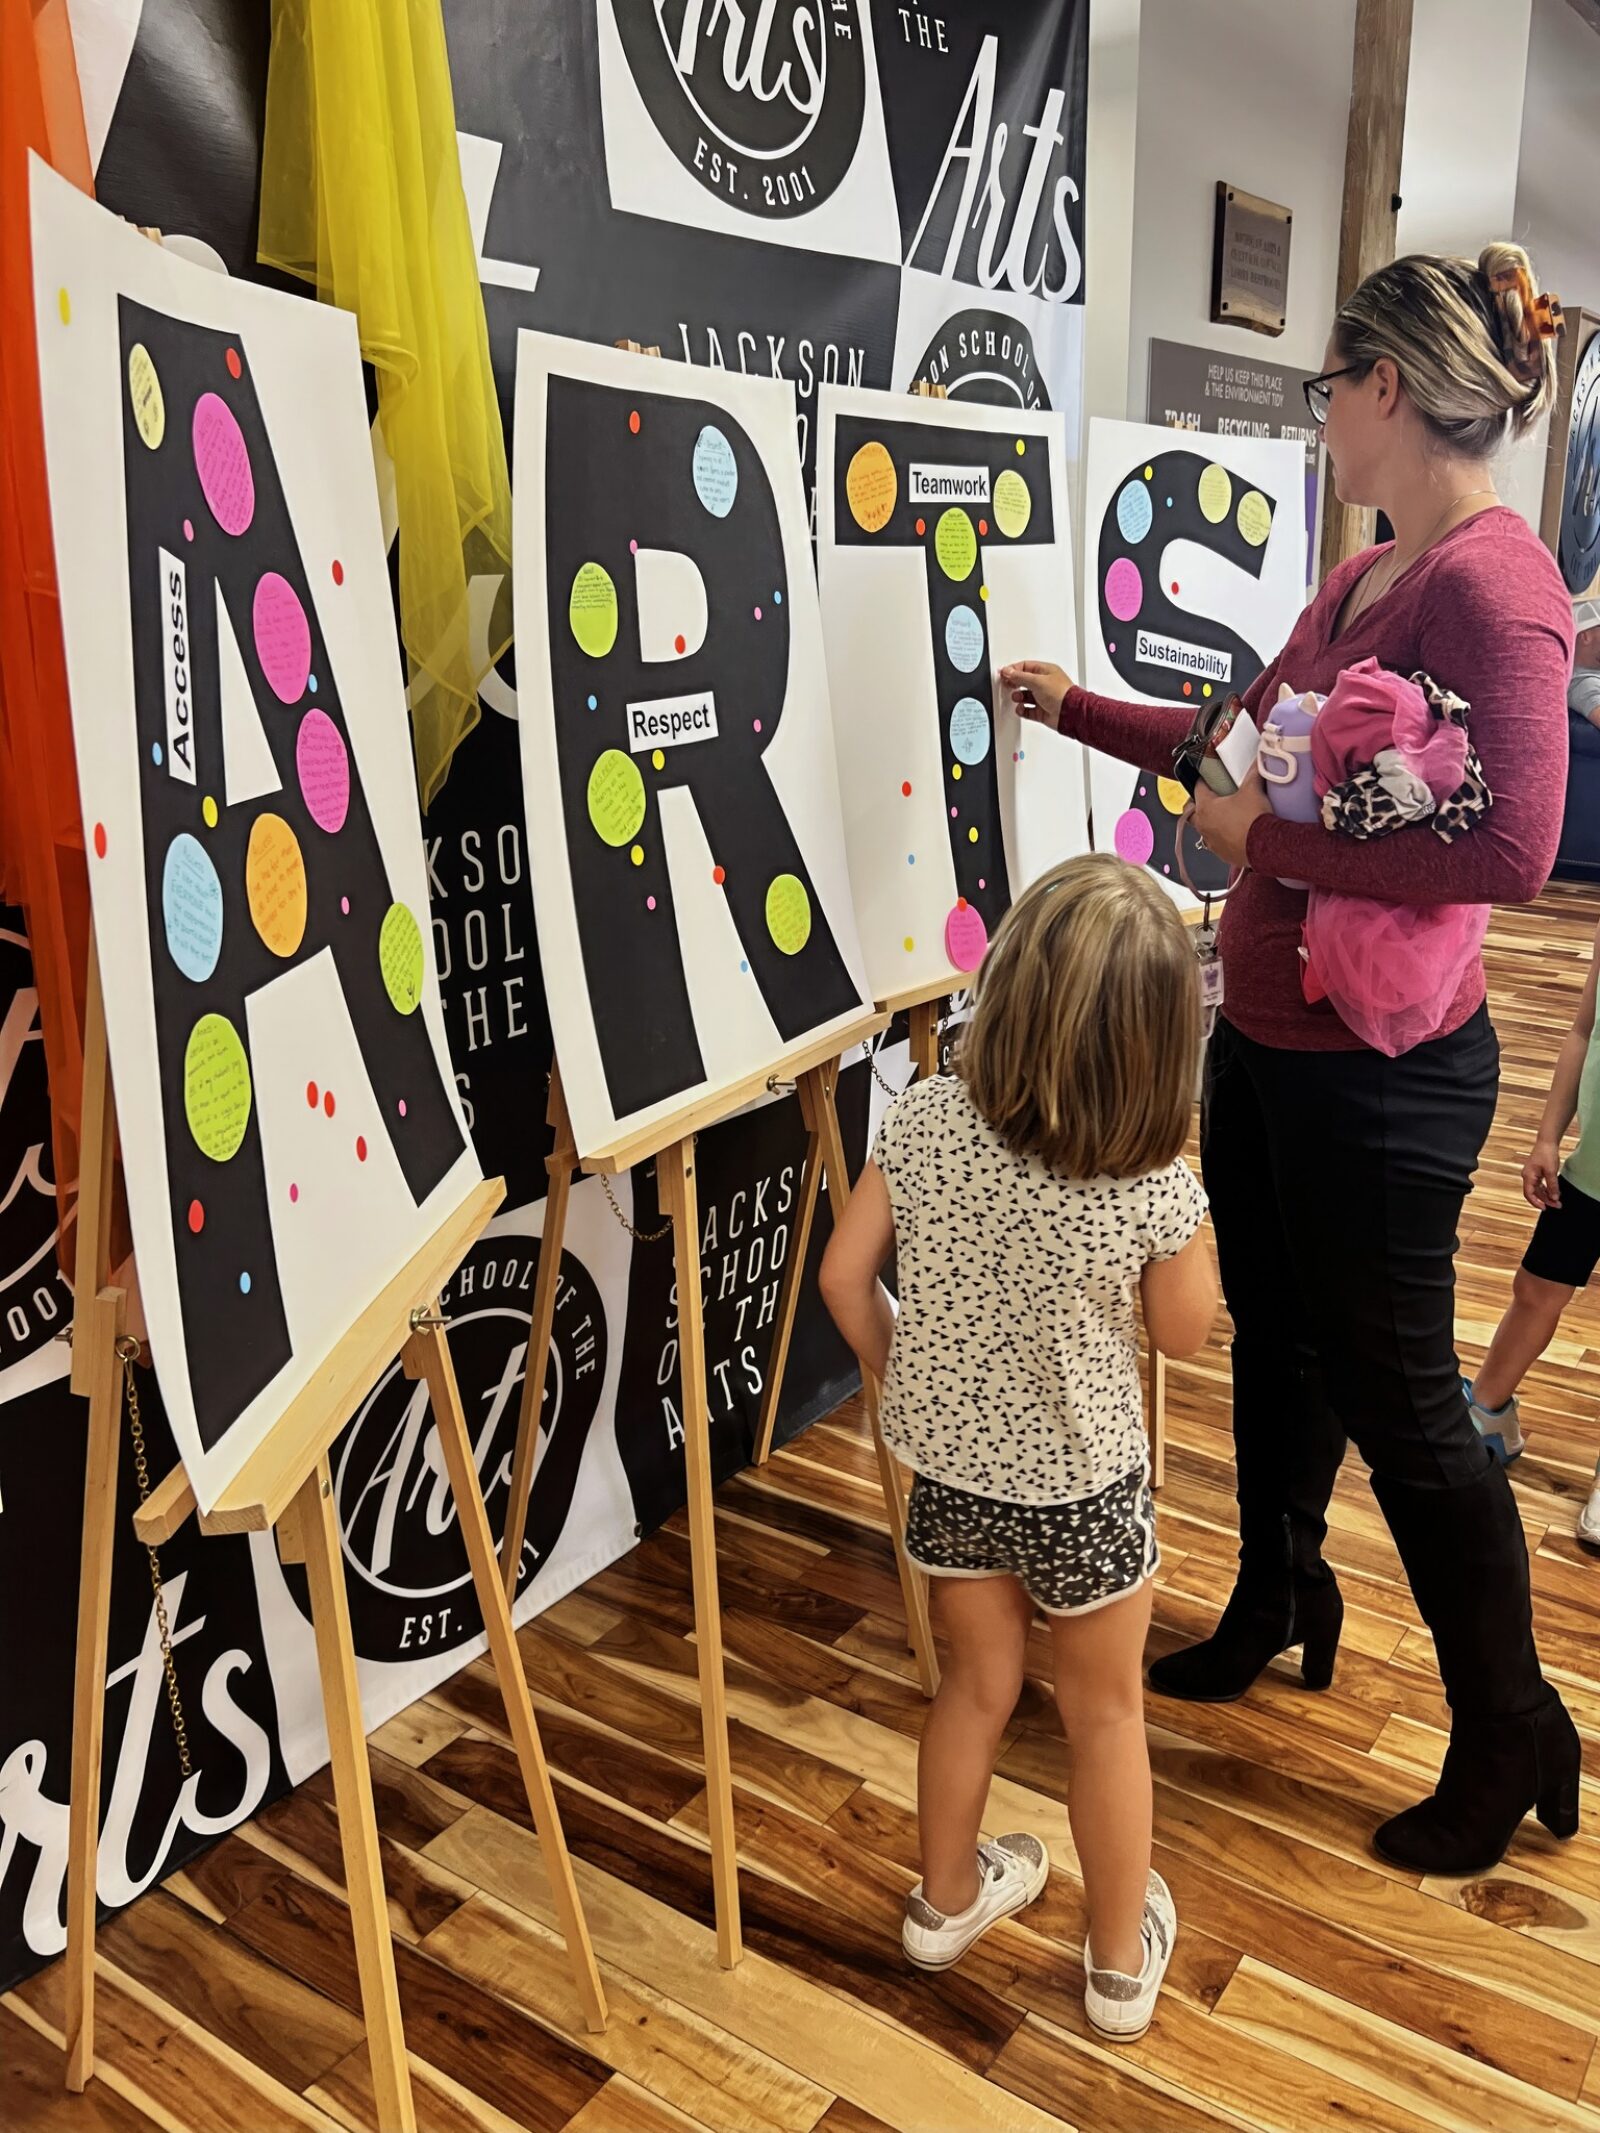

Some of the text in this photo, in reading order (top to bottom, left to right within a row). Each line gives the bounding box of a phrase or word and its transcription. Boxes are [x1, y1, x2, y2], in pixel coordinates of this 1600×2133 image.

[898, 8, 948, 53] THE
[693, 136, 816, 205] EST. 2001
[902, 34, 1081, 303] Arts
[959, 329, 1029, 378] SCHOOL
[1204, 381, 1285, 408] & THE ENVIRONMENT TIDY
[1207, 363, 1283, 392] HELP US KEEP THIS PLACE
[1165, 409, 1201, 431] TRASH
[1218, 417, 1270, 438] RECYCLING
[1281, 425, 1317, 447] RETURNS
[912, 471, 987, 497] Teamwork
[169, 570, 192, 772] Access
[1138, 636, 1229, 678] Sustainability
[631, 703, 711, 740] Respect
[438, 1258, 534, 1306] CHOOL
[571, 1314, 597, 1381] THE
[734, 1280, 780, 1342] TH
[661, 1345, 764, 1451] ATS
[399, 1608, 463, 1649] EST.
